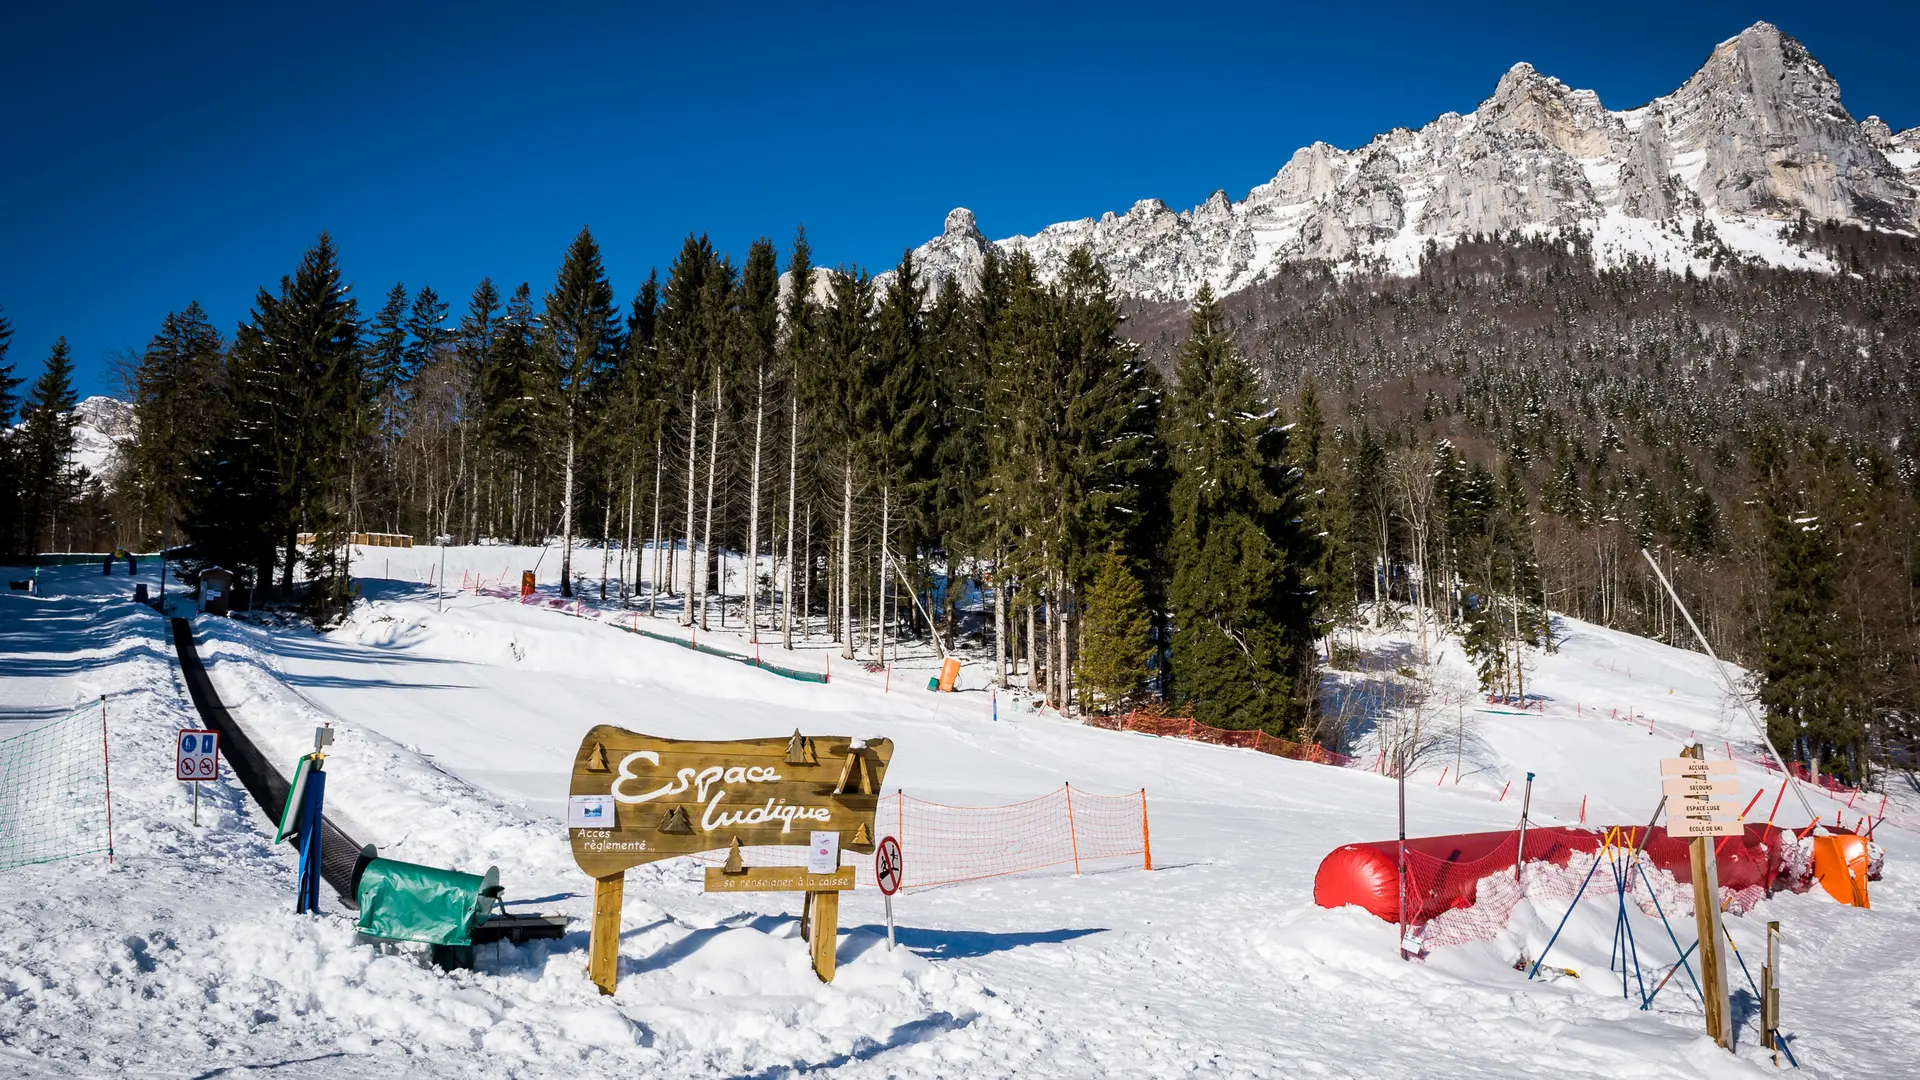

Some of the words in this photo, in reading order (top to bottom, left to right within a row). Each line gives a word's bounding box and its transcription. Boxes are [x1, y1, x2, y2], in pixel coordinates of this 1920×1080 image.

[611, 751, 782, 804] Espace
[740, 879, 793, 890] renseigner
[797, 876, 804, 886] à
[806, 877, 815, 886] la
[818, 877, 849, 886] caisse
